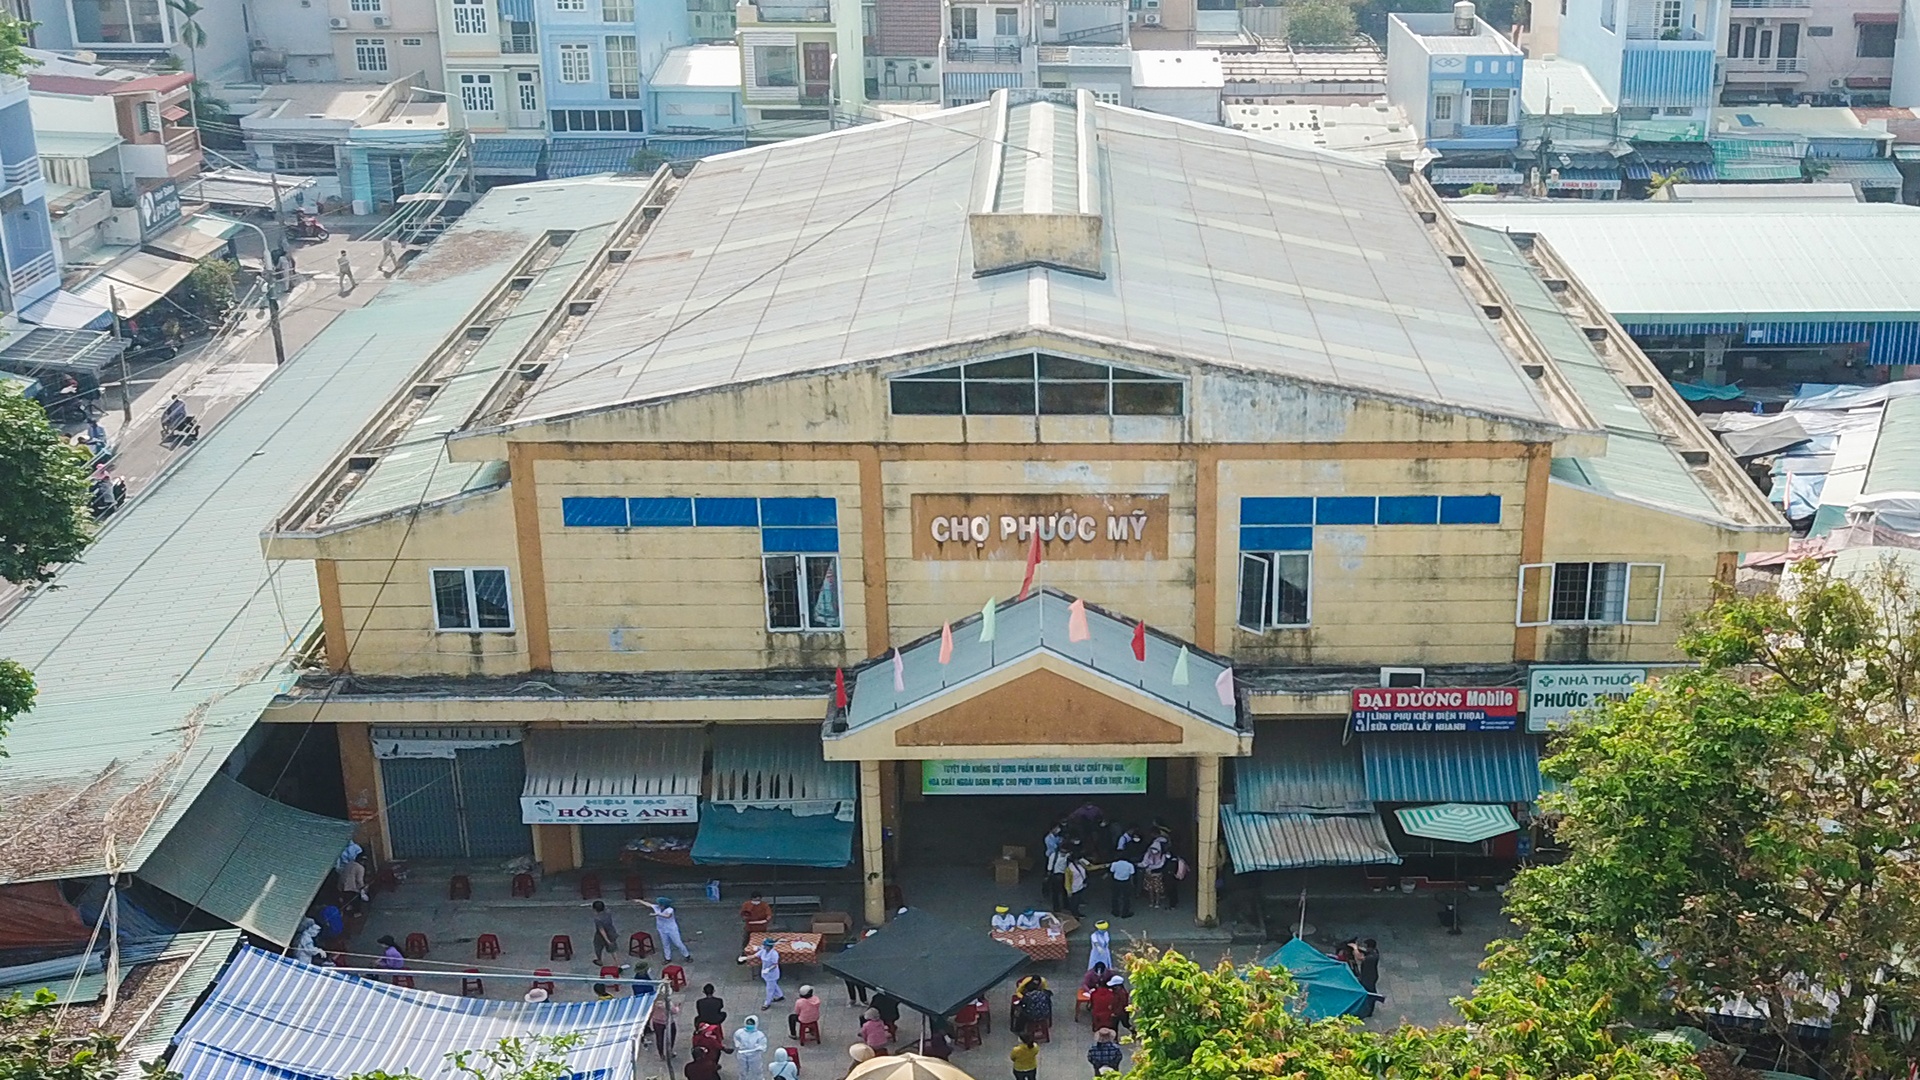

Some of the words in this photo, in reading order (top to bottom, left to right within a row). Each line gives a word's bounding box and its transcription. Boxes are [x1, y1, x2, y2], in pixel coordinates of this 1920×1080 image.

[931, 514, 990, 548] CHỢ
[1000, 508, 1097, 542] PHƯỚC
[1107, 509, 1148, 541] MỸ
[1559, 674, 1588, 685] NHÀ
[1591, 672, 1640, 685] THUỐC
[1358, 692, 1391, 710] ĐẠI
[1396, 691, 1462, 707] DƯƠNG
[1466, 691, 1513, 706] Mobile
[1533, 690, 1588, 707] PHƯỚC
[557, 805, 630, 818] HỒNG
[635, 808, 689, 817] ANH
